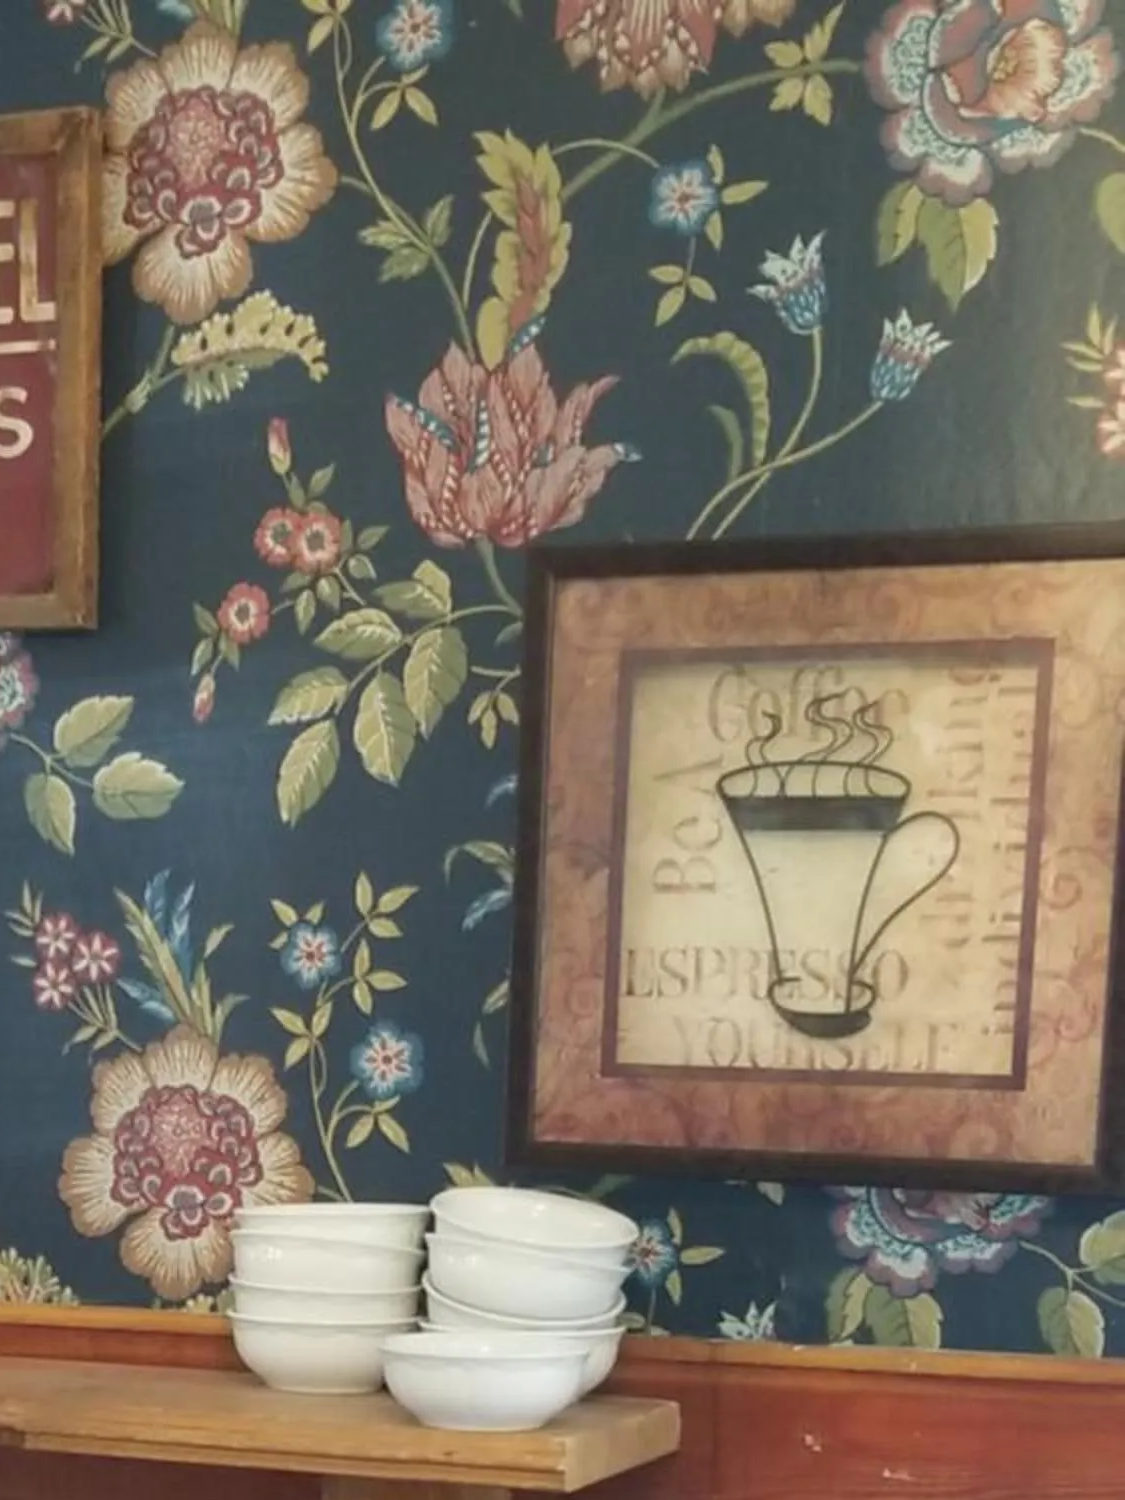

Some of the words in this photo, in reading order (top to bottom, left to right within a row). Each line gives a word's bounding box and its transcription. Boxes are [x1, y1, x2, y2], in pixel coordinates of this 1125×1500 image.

[708, 665, 909, 743] Coffee
[918, 667, 992, 950] drking
[624, 947, 909, 1000] ESPRESSO
